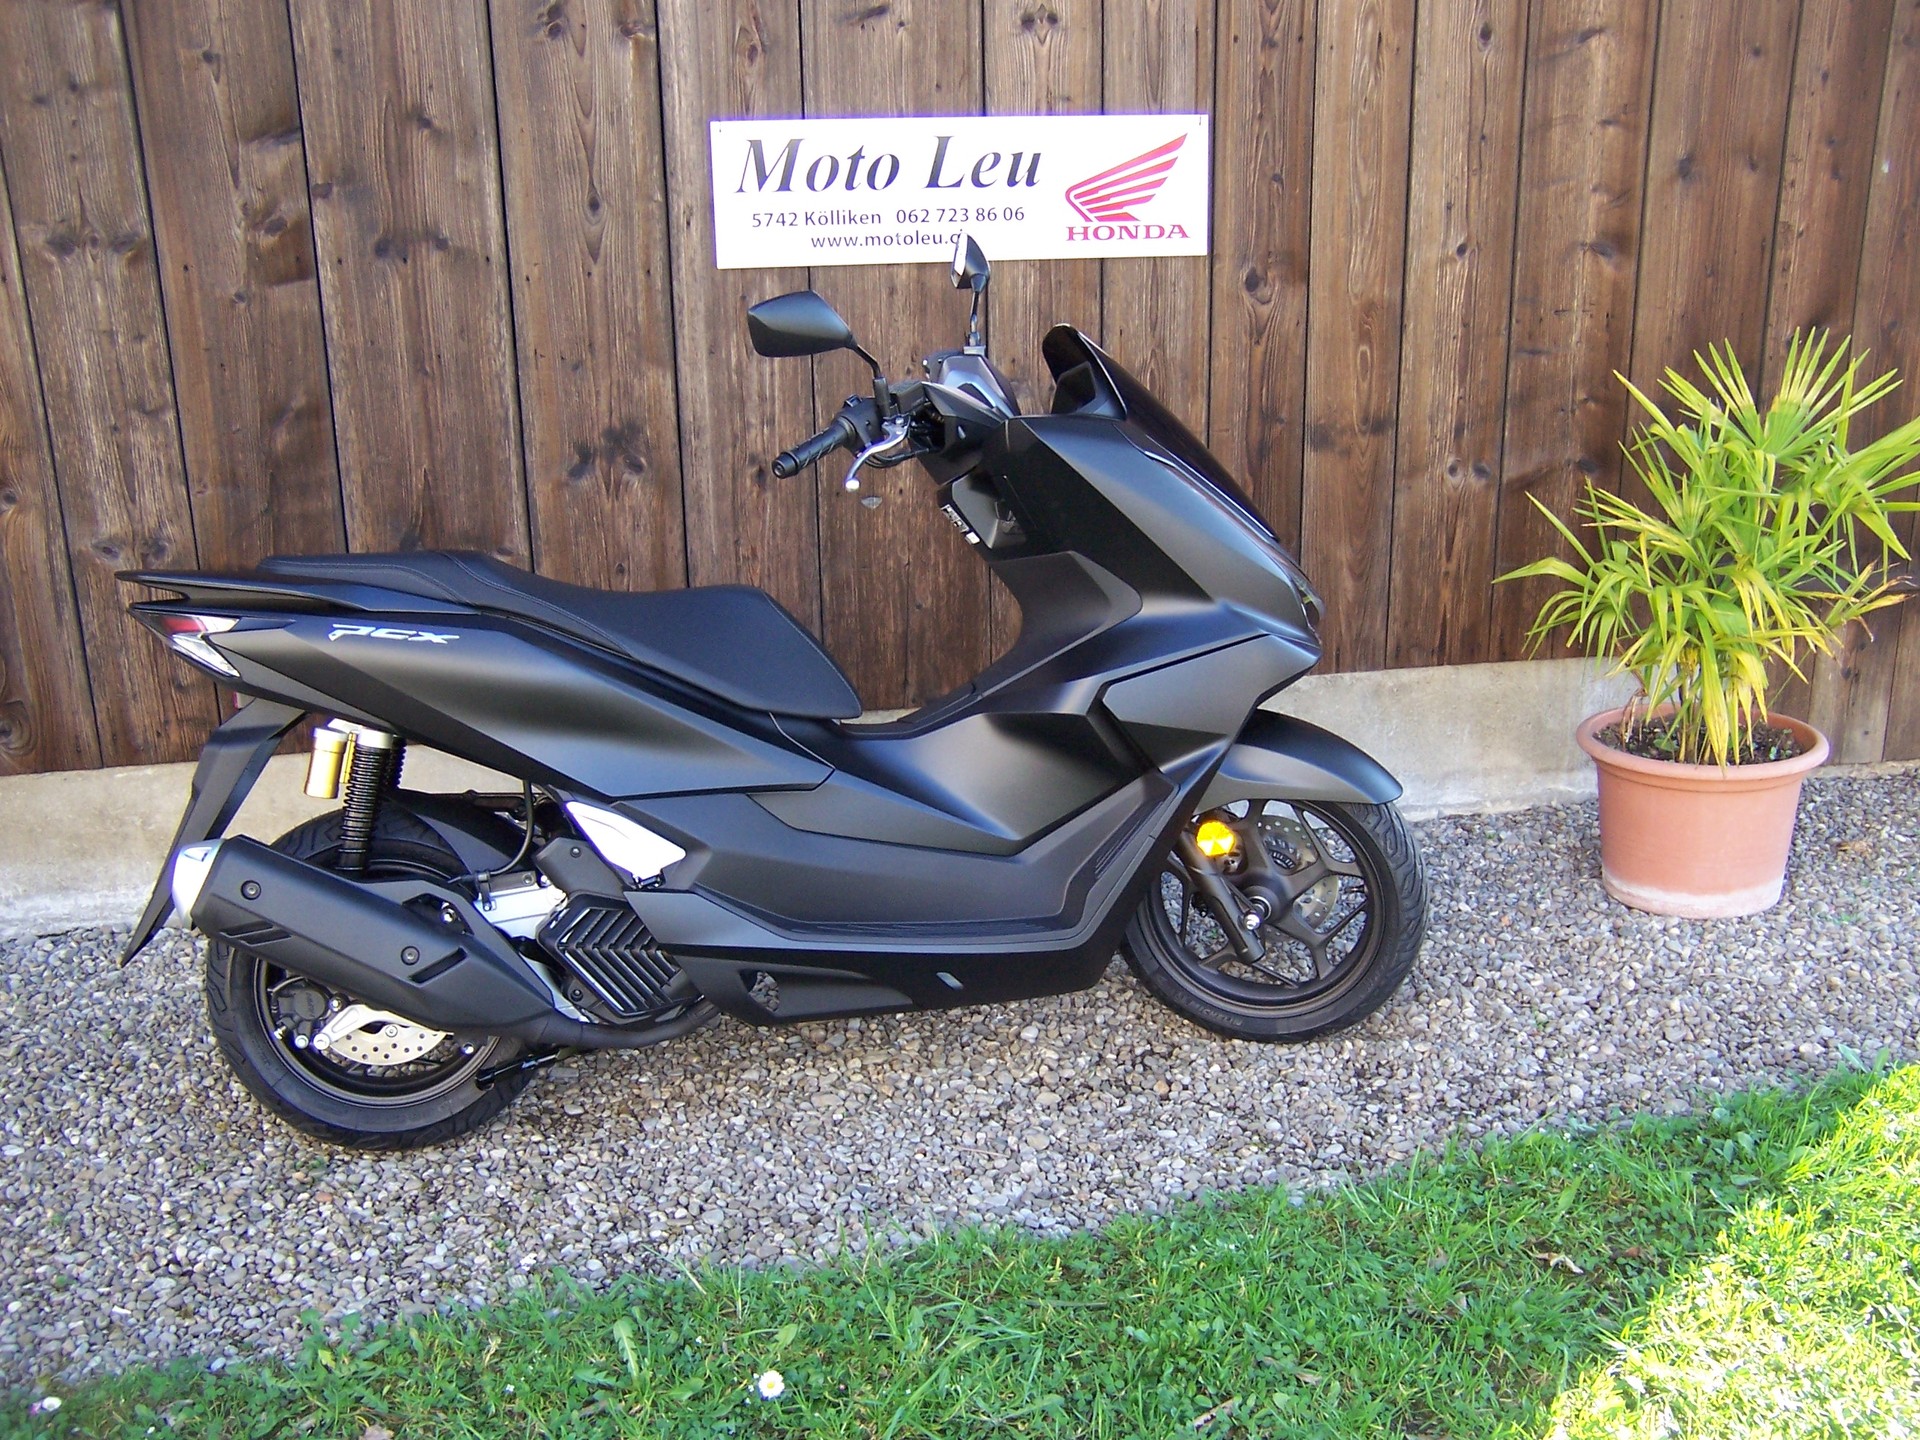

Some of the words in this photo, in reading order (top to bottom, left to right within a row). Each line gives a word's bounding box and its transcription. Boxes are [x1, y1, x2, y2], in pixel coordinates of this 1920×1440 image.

[735, 138, 900, 193] Moto
[923, 135, 1042, 189] Leu
[752, 212, 798, 228] 5742
[804, 209, 882, 226] Kölliken
[896, 208, 930, 224] 062
[936, 207, 969, 223] 723
[975, 206, 998, 222] 86
[1003, 206, 1025, 221] 06
[810, 229, 962, 248] www.motoleu.c
[1066, 224, 1191, 242] HONDA
[328, 623, 460, 645] PCX
